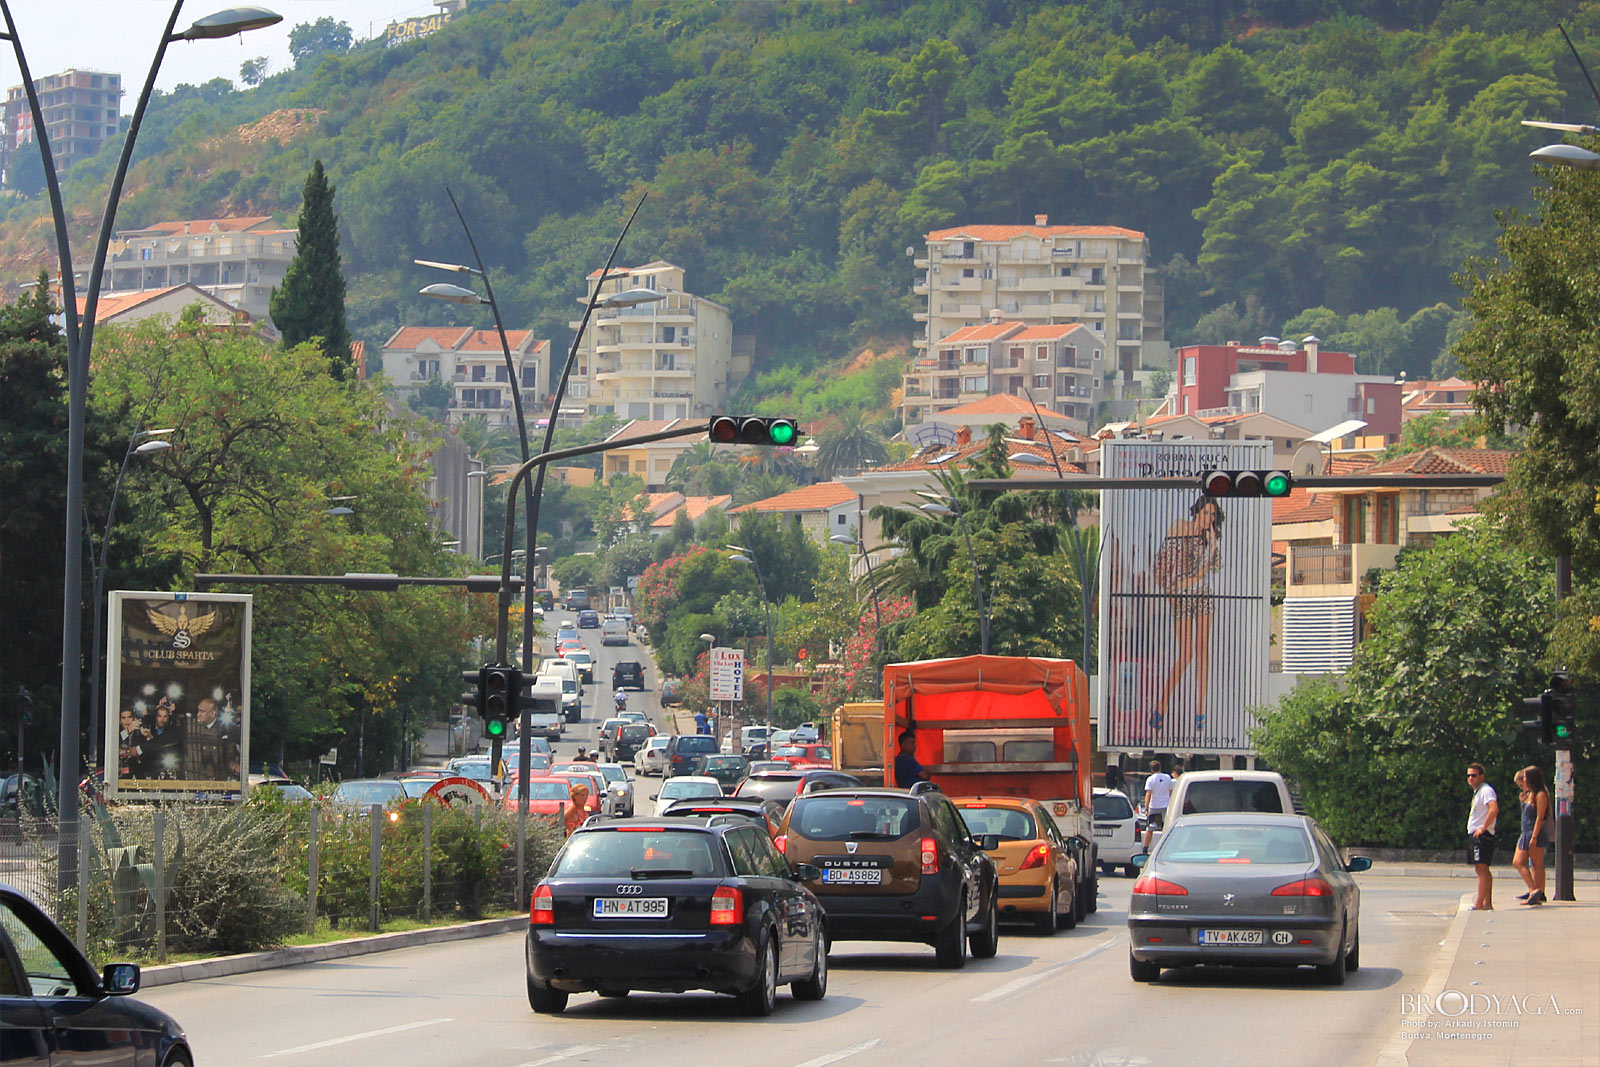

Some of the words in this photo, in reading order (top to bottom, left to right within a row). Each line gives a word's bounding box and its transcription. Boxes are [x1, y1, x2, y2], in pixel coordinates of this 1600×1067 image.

[387, 21, 417, 39] FOR
[1156, 453, 1195, 462] ROBNA
[148, 649, 175, 659] CLUB
[176, 650, 214, 660] SPARTA
[721, 651, 741, 660] Lux
[829, 870, 842, 880] BD
[848, 870, 880, 880] AS862
[603, 900, 619, 913] HN
[626, 900, 665, 913] AT995
[1206, 931, 1222, 942] TV
[1226, 931, 1261, 942] AK487
[1275, 933, 1288, 943] CH
